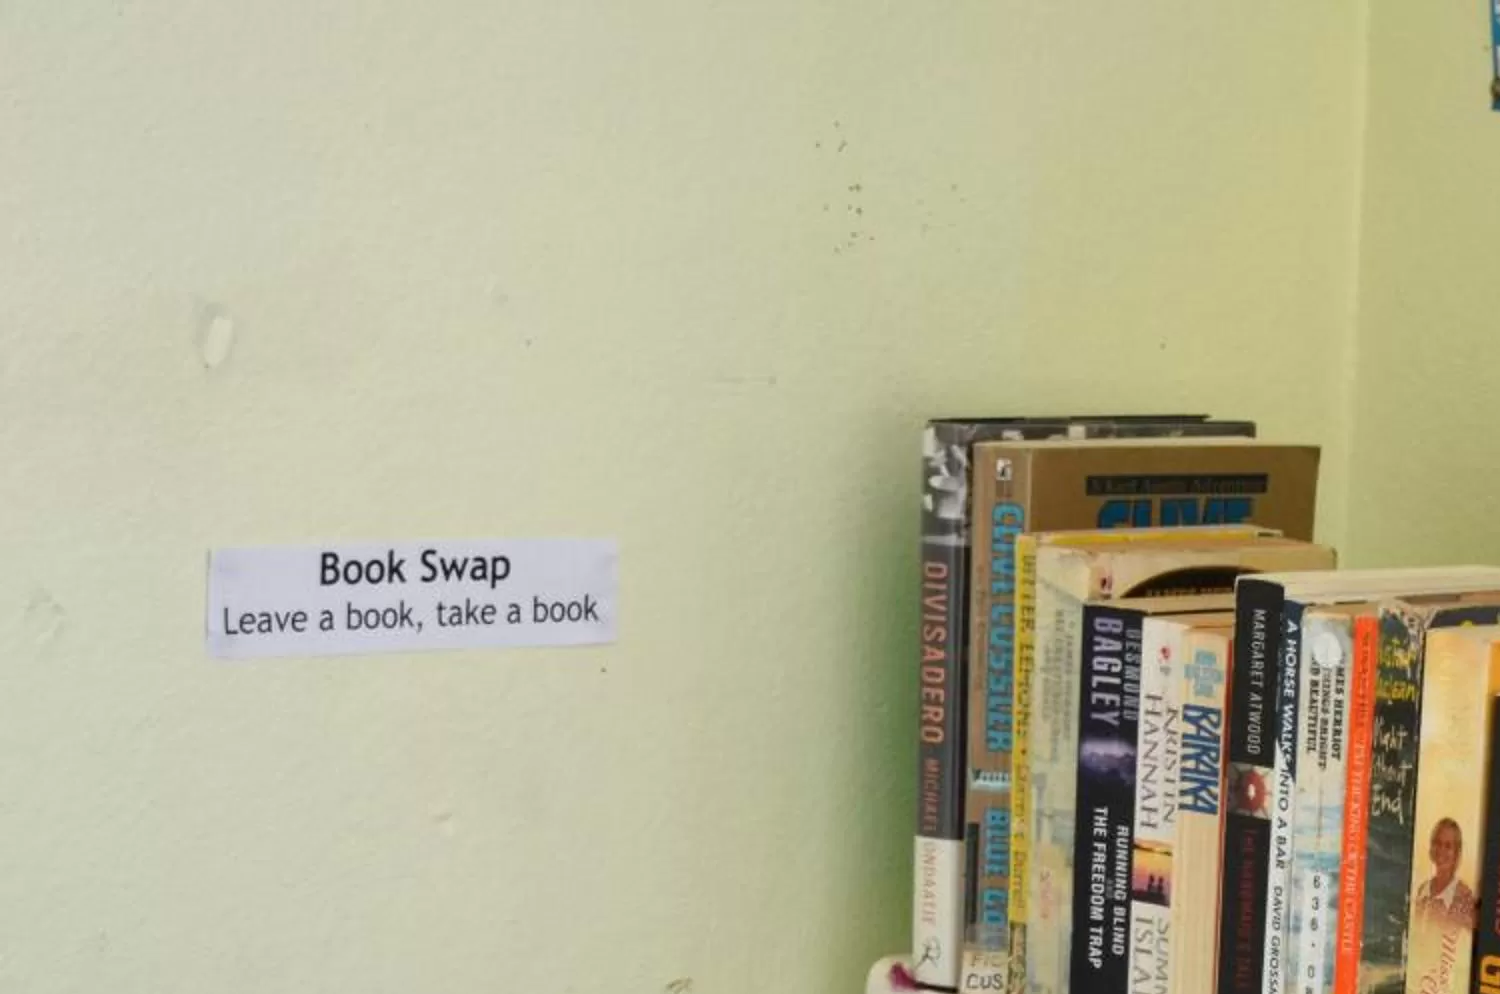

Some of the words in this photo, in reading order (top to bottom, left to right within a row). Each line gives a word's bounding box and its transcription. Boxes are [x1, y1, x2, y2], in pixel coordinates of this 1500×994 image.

[319, 550, 407, 586] Book
[420, 549, 512, 589] Swap
[224, 606, 308, 635] Leave
[319, 608, 334, 632] a
[346, 600, 424, 634] book,
[436, 598, 497, 628] take
[506, 602, 521, 625] a
[533, 594, 599, 624] book
[1286, 619, 1298, 633] A
[920, 560, 949, 744] DIVISADERO
[1090, 616, 1124, 727] BAGLEY
[1122, 628, 1142, 722] DESMOND
[1250, 608, 1267, 689] MARGARET
[1283, 638, 1298, 698] HORSE
[1247, 691, 1264, 756] ATWOOD
[1306, 679, 1320, 754] BEAUTIFUL
[1331, 698, 1344, 762] HERRIOT
[1139, 693, 1163, 830] HANNAH
[1163, 704, 1180, 824] KRISTIN
[984, 806, 1011, 878] BLUE
[1093, 806, 1109, 838] THE
[1275, 836, 1287, 870] BAR
[1277, 817, 1288, 830] A
[1089, 841, 1107, 922] FREEDOM
[1113, 824, 1130, 903] RUNNING
[1111, 905, 1127, 956] BLIND
[1271, 885, 1284, 931] DAVID
[1087, 927, 1104, 969] TRAP
[966, 972, 1005, 990] CUS
